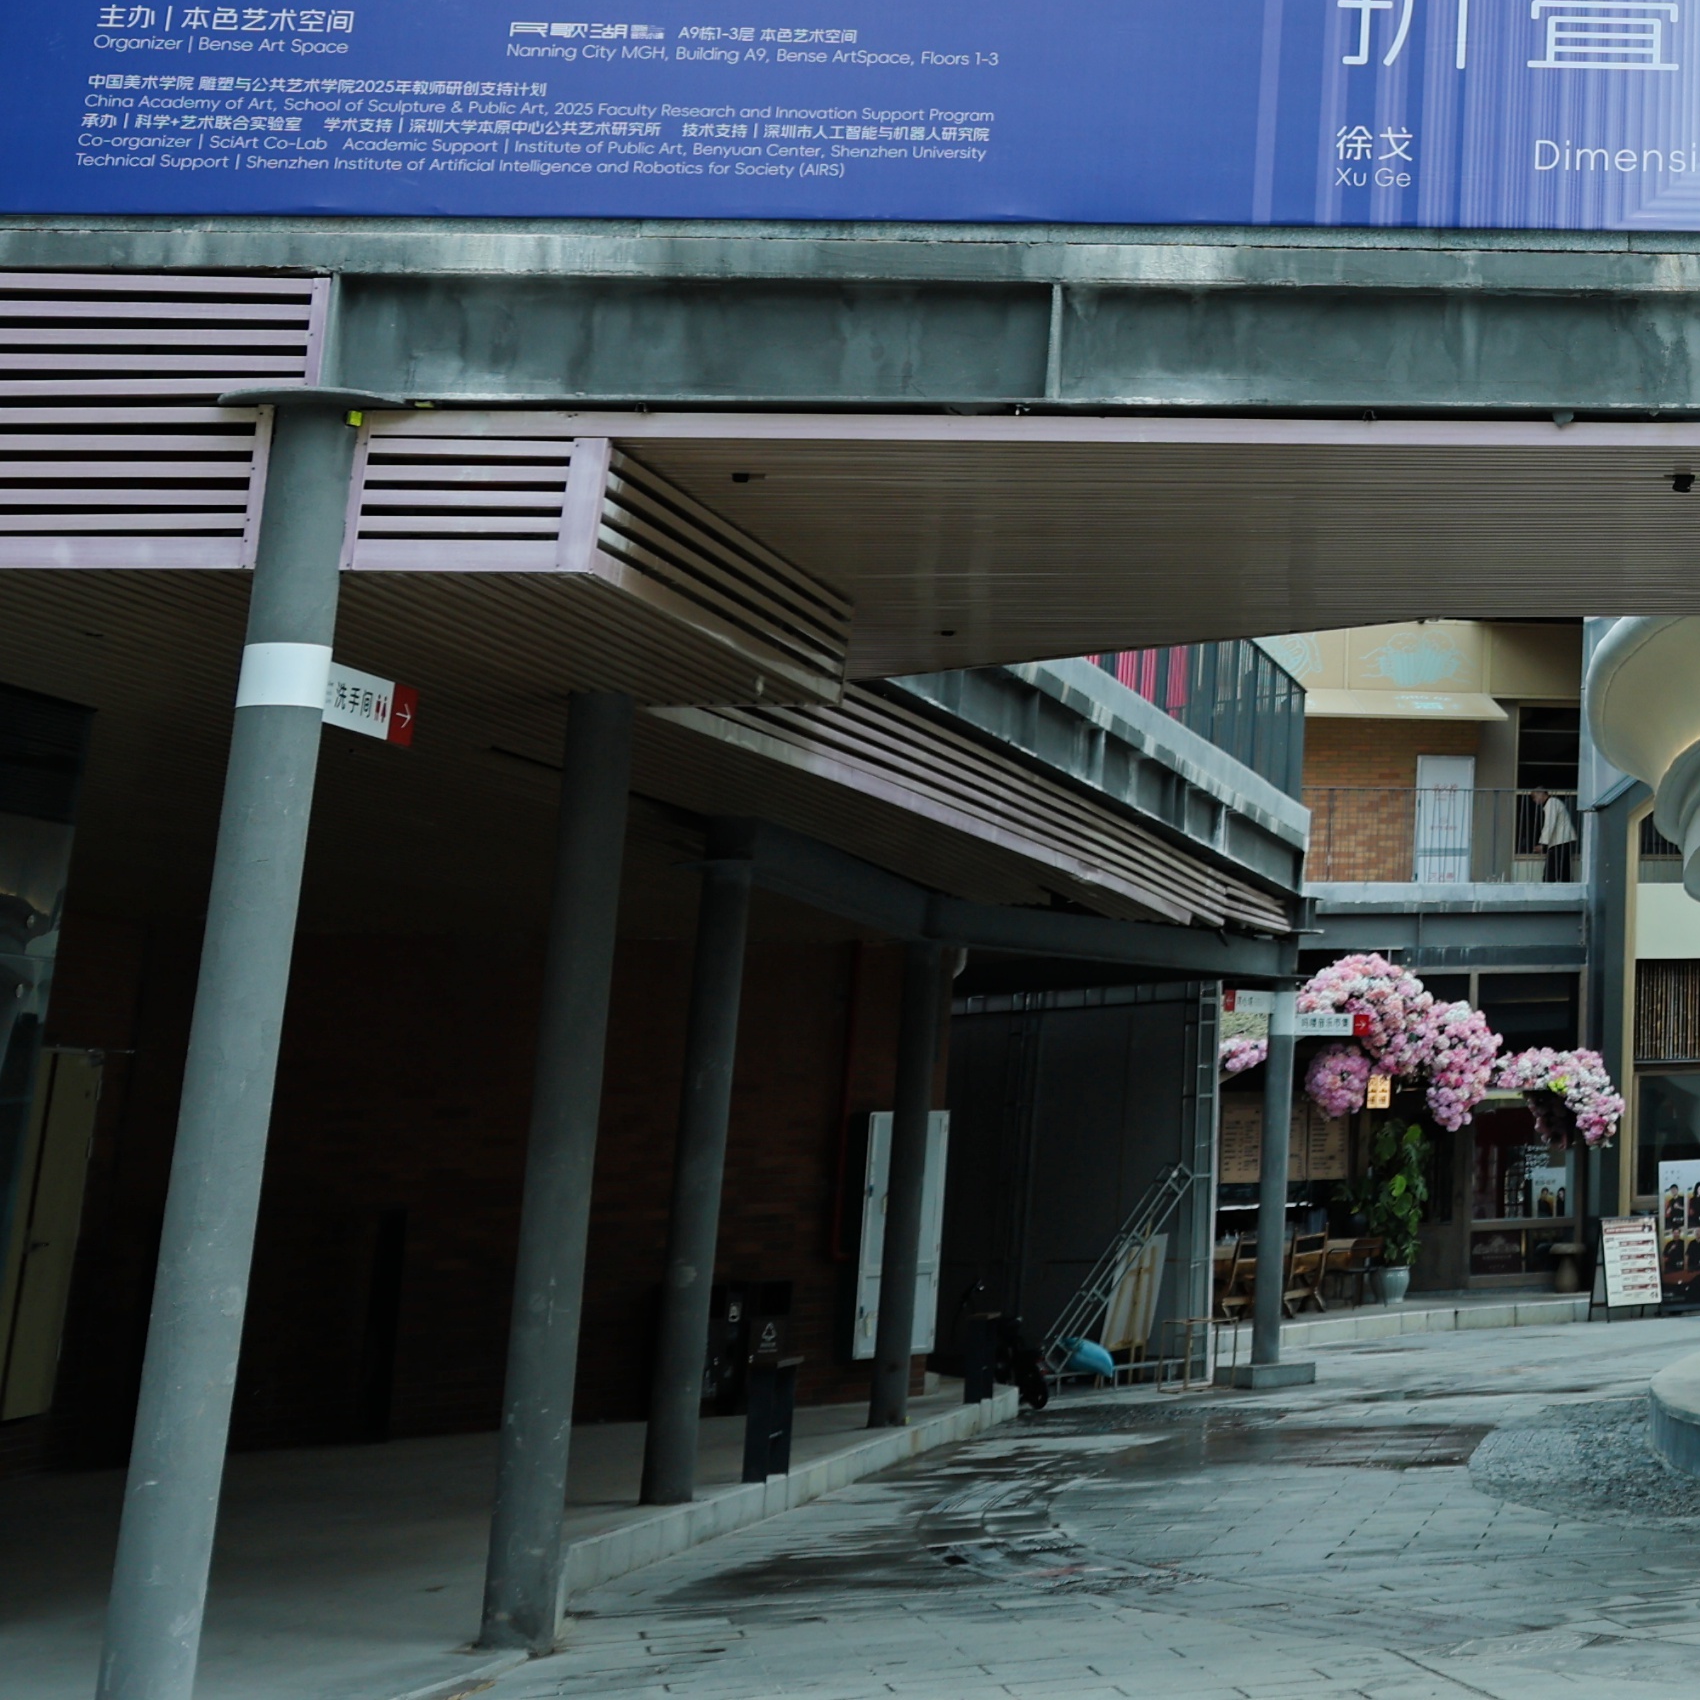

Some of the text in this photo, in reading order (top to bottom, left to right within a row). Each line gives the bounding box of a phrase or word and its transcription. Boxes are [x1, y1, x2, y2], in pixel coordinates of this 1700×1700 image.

[97, 4, 354, 33] 主办 本色艺术空间
[94, 35, 348, 56] Organizer Bense Art Space
[678, 27, 755, 41] A9栋1-3层
[760, 28, 857, 43] 本色艺术空间
[507, 44, 998, 66] Nanning City MGH, Building A9, Bense ArtSpace, Floors 1-3
[89, 74, 194, 90] 中国美术学院
[85, 94, 994, 124] China Academy of Art, School of Sculpture & Public Art, 2025 Faculty Research and Innovation Support Program
[81, 113, 117, 128] 承办
[324, 117, 392, 132] 学术支持
[682, 123, 747, 138] 技术支持
[78, 133, 986, 162] Co-organizer SciArt Co-Lab Academic Support Institute of Public Art, Benyuan Center, Shenzhen University
[1336, 126, 1412, 164] 徐戈
[76, 153, 845, 178] Technical Support Shenzhen Institute of Artificial Intelligence and Robotics for Society (AIRS)
[1335, 165, 1411, 191] Xu Ge
[334, 682, 373, 719] 洗手间
